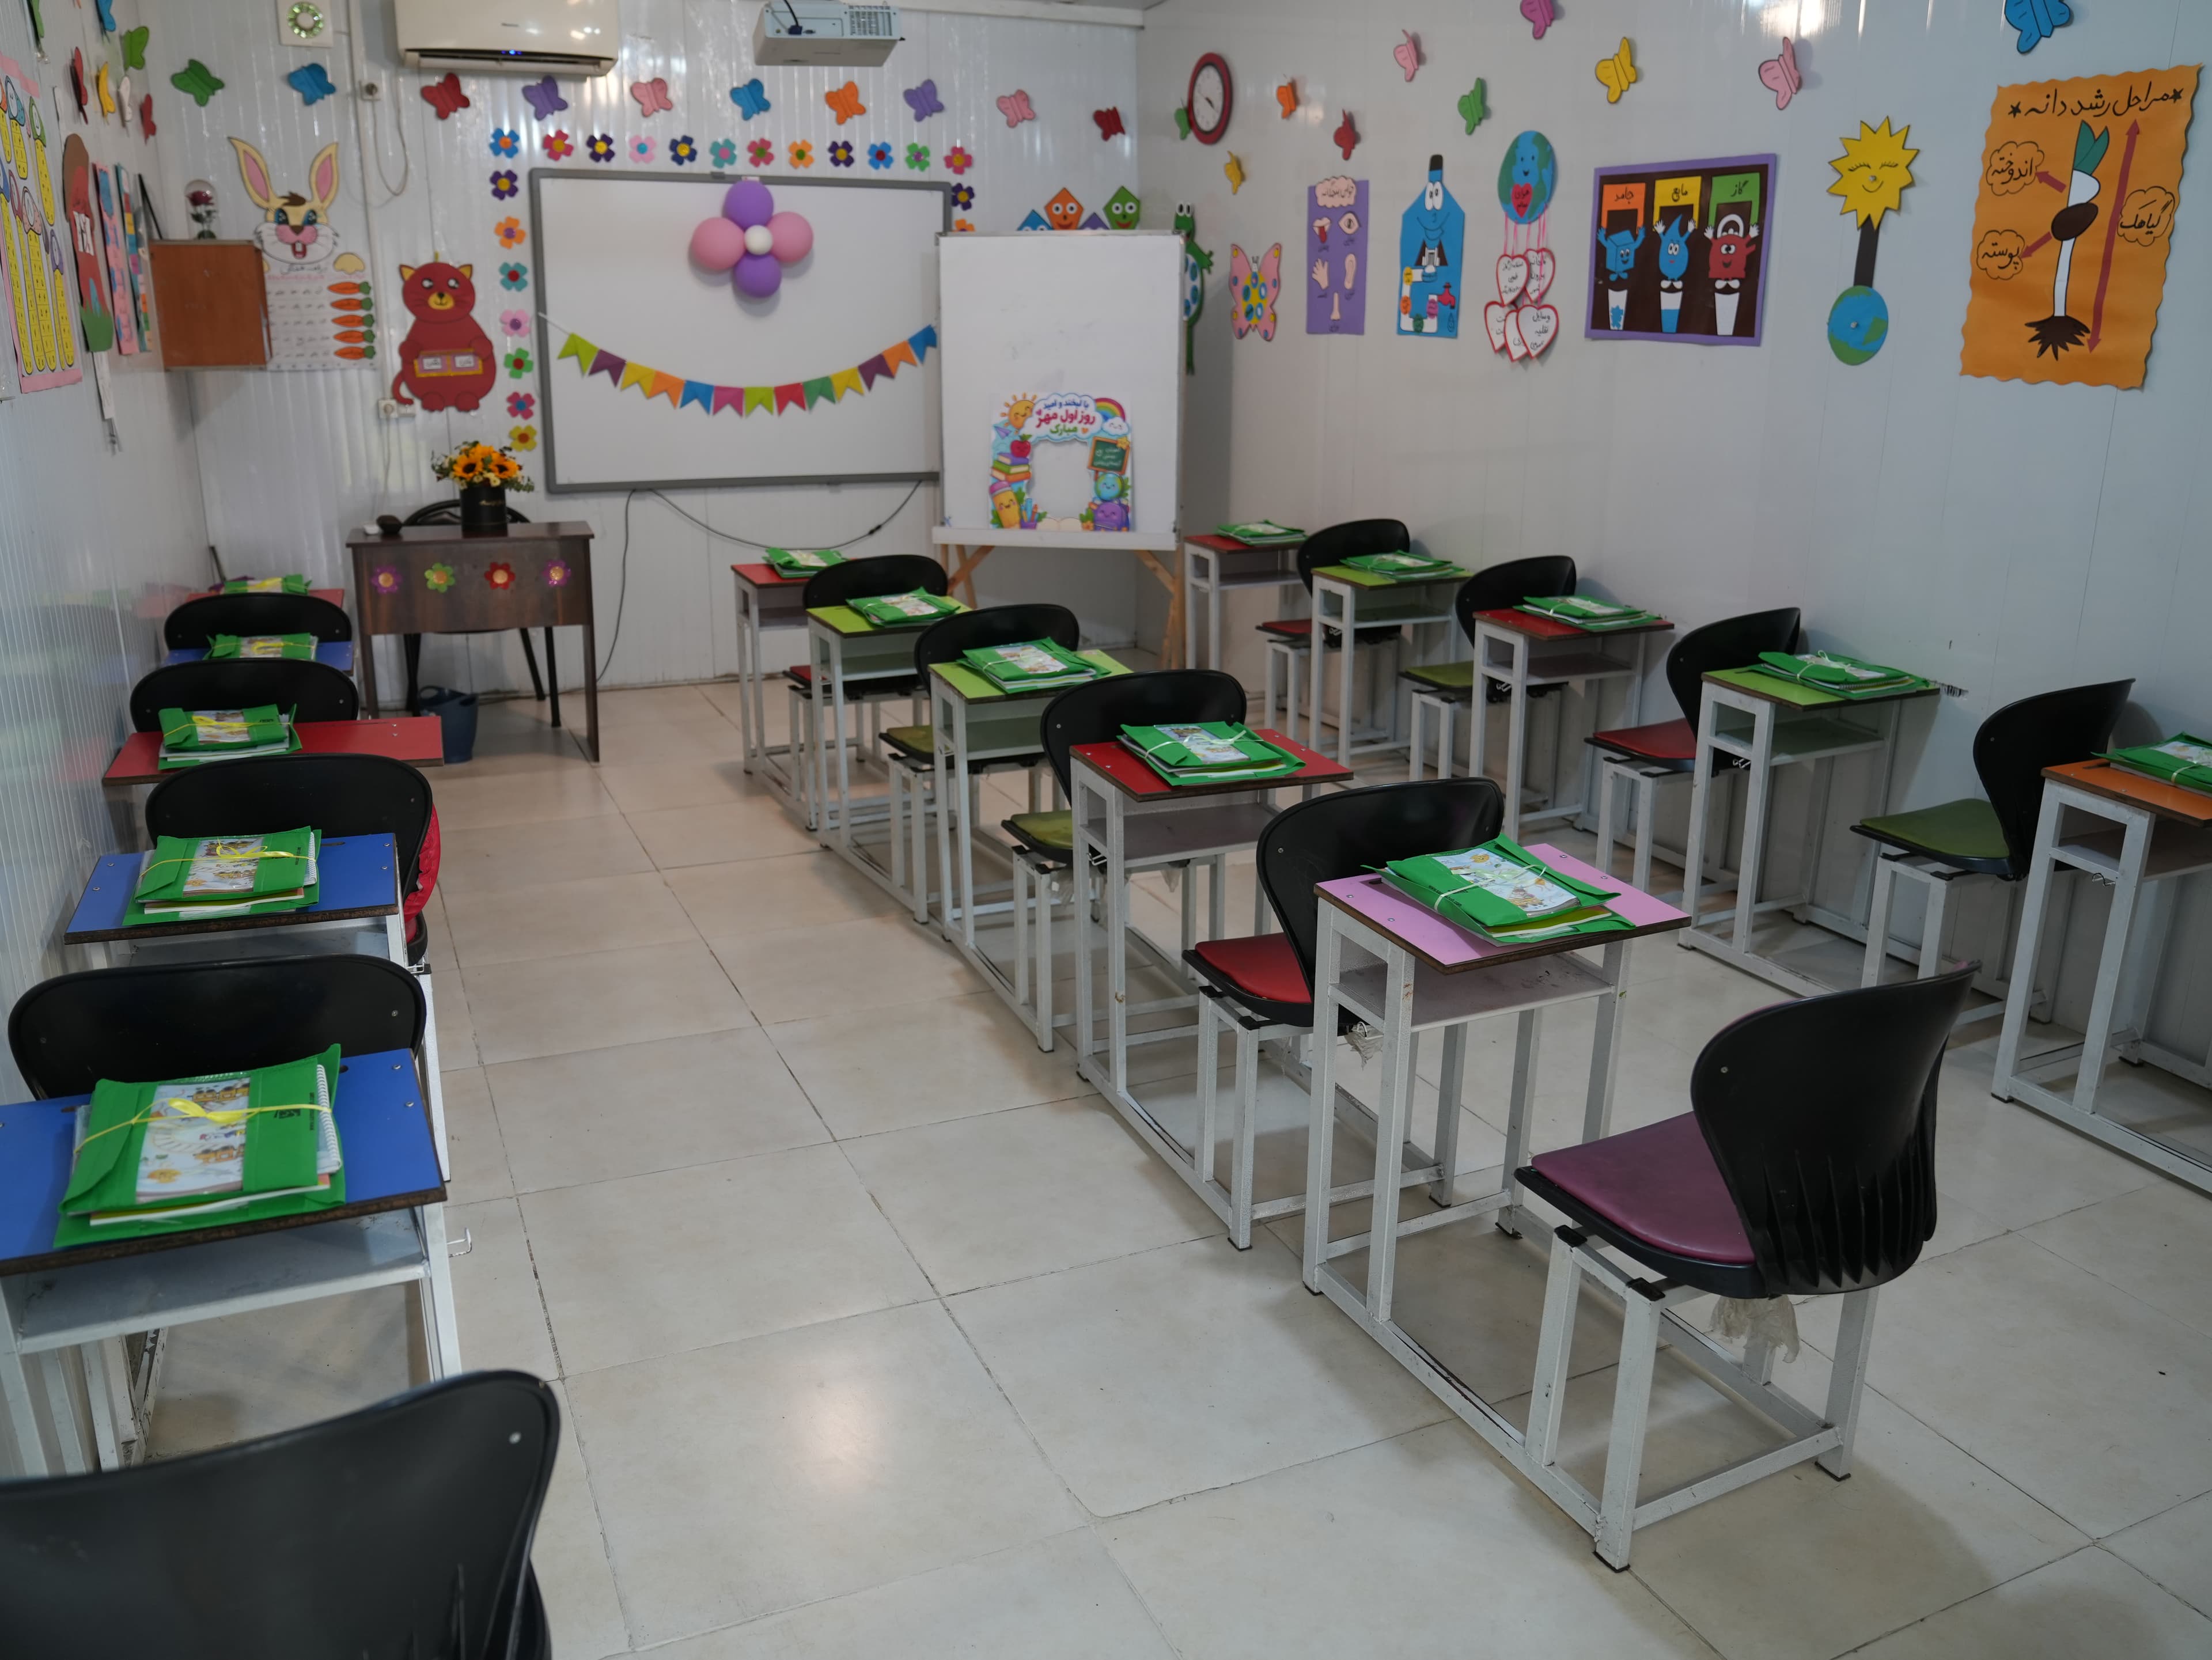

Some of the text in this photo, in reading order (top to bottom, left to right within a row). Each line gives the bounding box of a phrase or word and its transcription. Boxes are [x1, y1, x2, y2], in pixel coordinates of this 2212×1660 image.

[2024, 81, 2170, 117] مراحل رشد دانه
[1991, 152, 2033, 185] اندوخته
[1615, 187, 1634, 204] جامد
[1672, 183, 1688, 202] مایع
[1730, 179, 1749, 197] گاز
[2119, 199, 2173, 235] گیاهک
[1981, 242, 2020, 270] پوسته
[1035, 409, 1096, 429] روز اول مهر
[1050, 423, 1078, 436] مبارک
